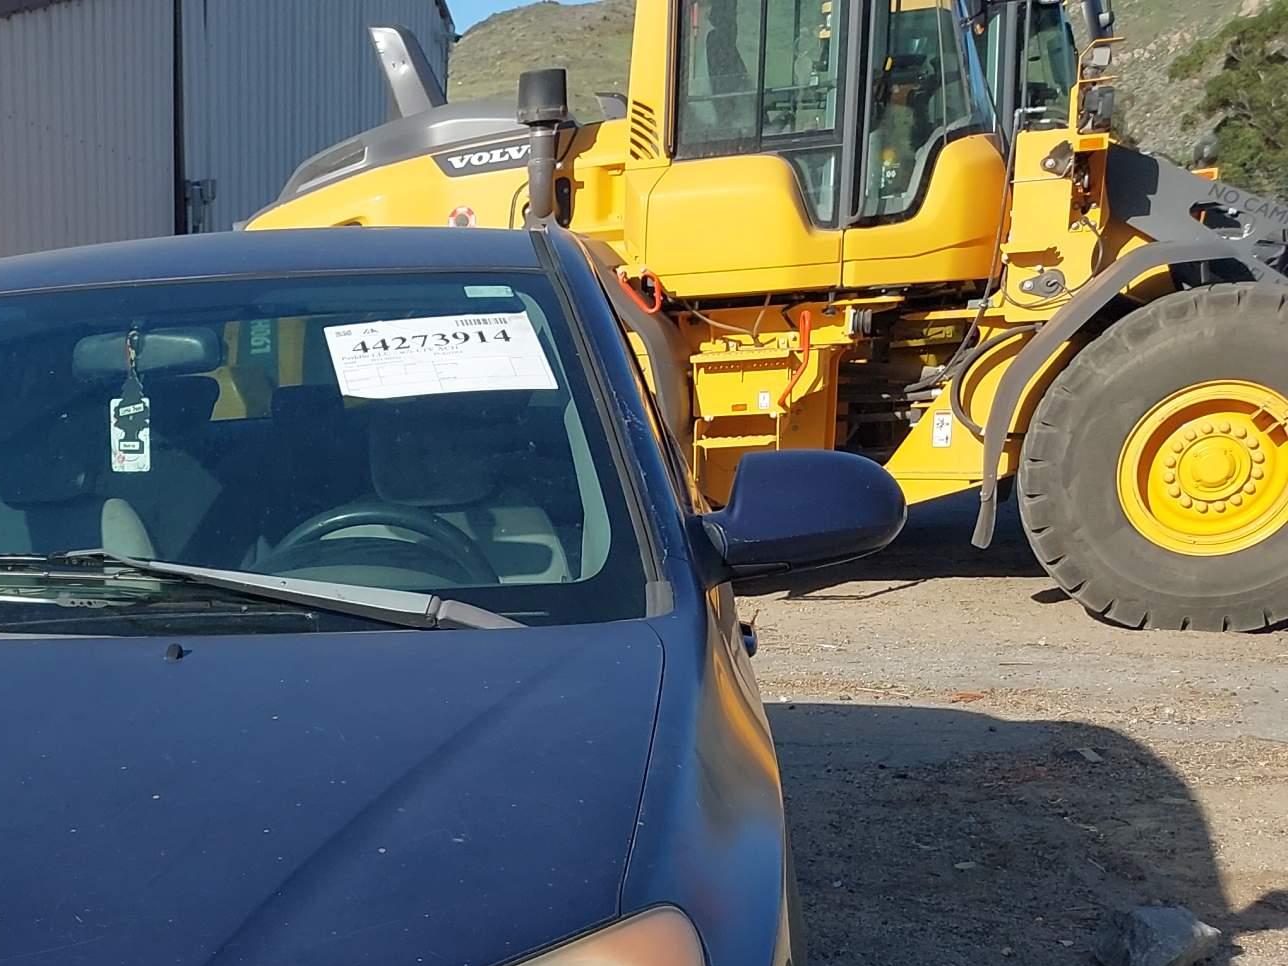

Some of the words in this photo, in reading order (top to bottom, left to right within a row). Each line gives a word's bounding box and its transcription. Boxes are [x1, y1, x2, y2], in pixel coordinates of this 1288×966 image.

[447, 144, 531, 169] VOLV
[1208, 183, 1240, 204] NO
[351, 329, 512, 353] 44273914
